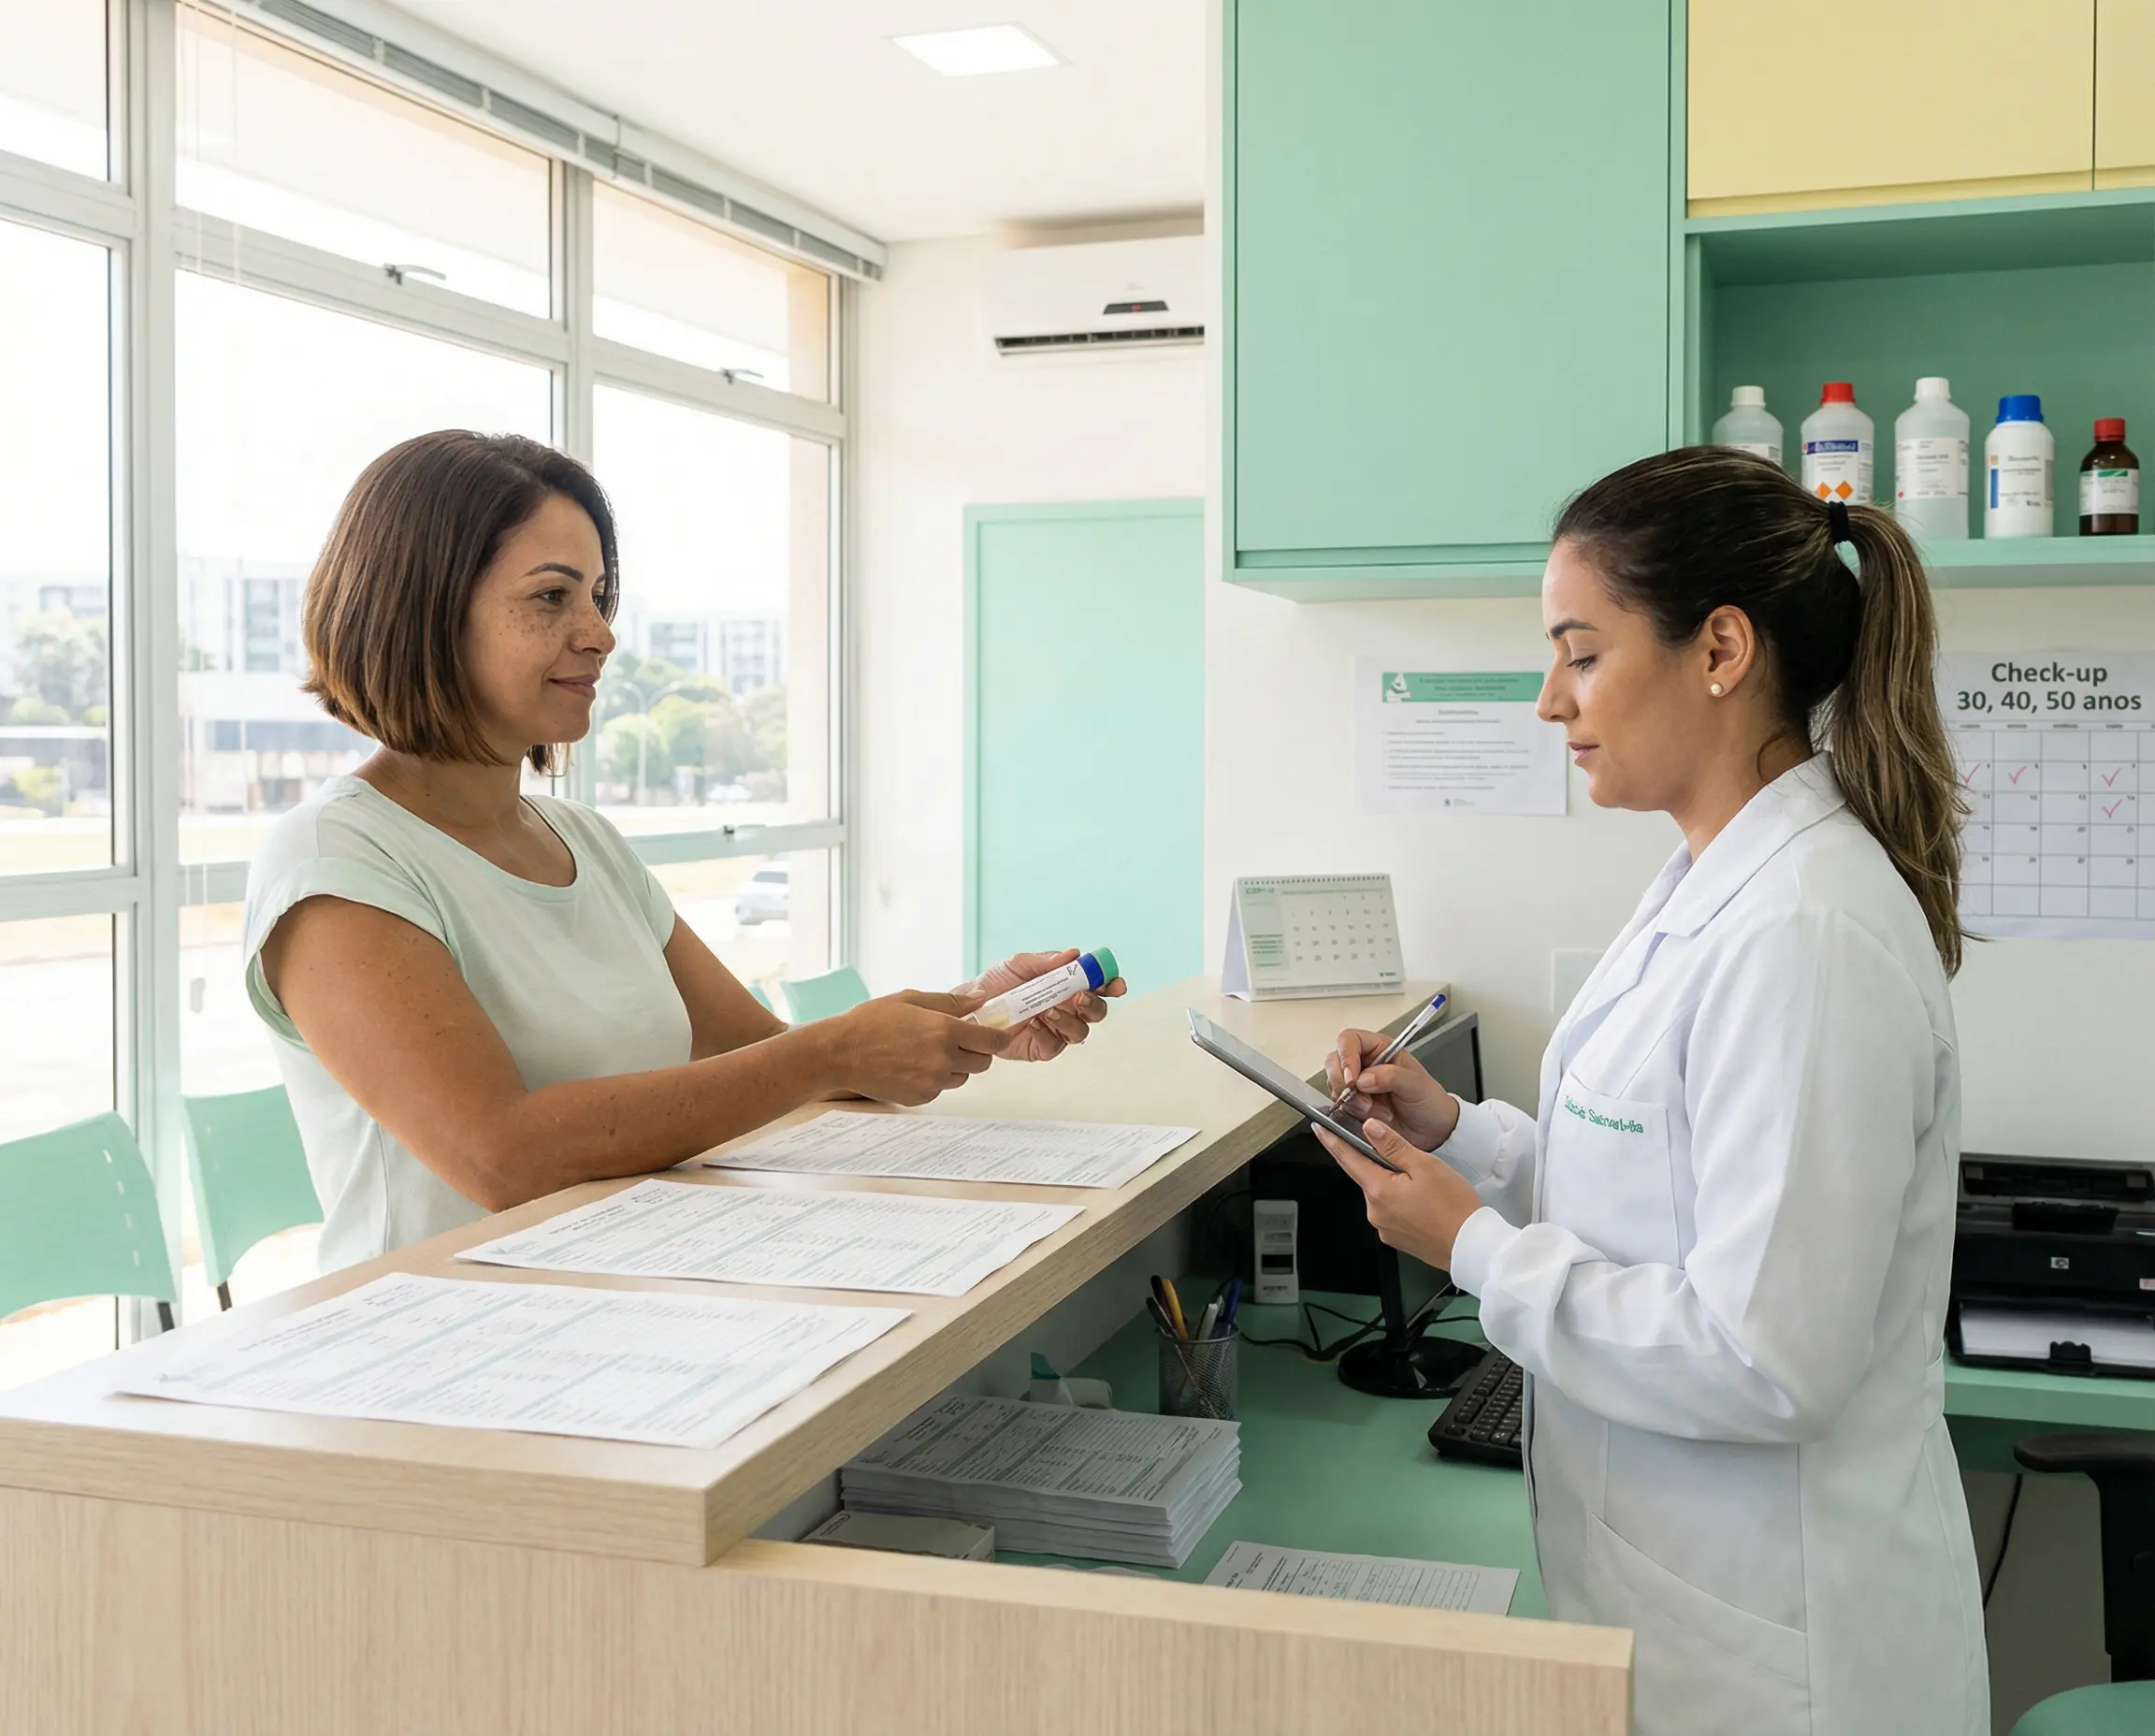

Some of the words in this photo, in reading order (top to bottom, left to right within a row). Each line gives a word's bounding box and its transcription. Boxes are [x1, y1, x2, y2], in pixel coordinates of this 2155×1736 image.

[1991, 661, 2108, 687] Check-up
[1957, 690, 1993, 714] 30,
[2001, 690, 2038, 714] 40,
[2046, 690, 2075, 710] 50
[2082, 694, 2142, 710] anos
